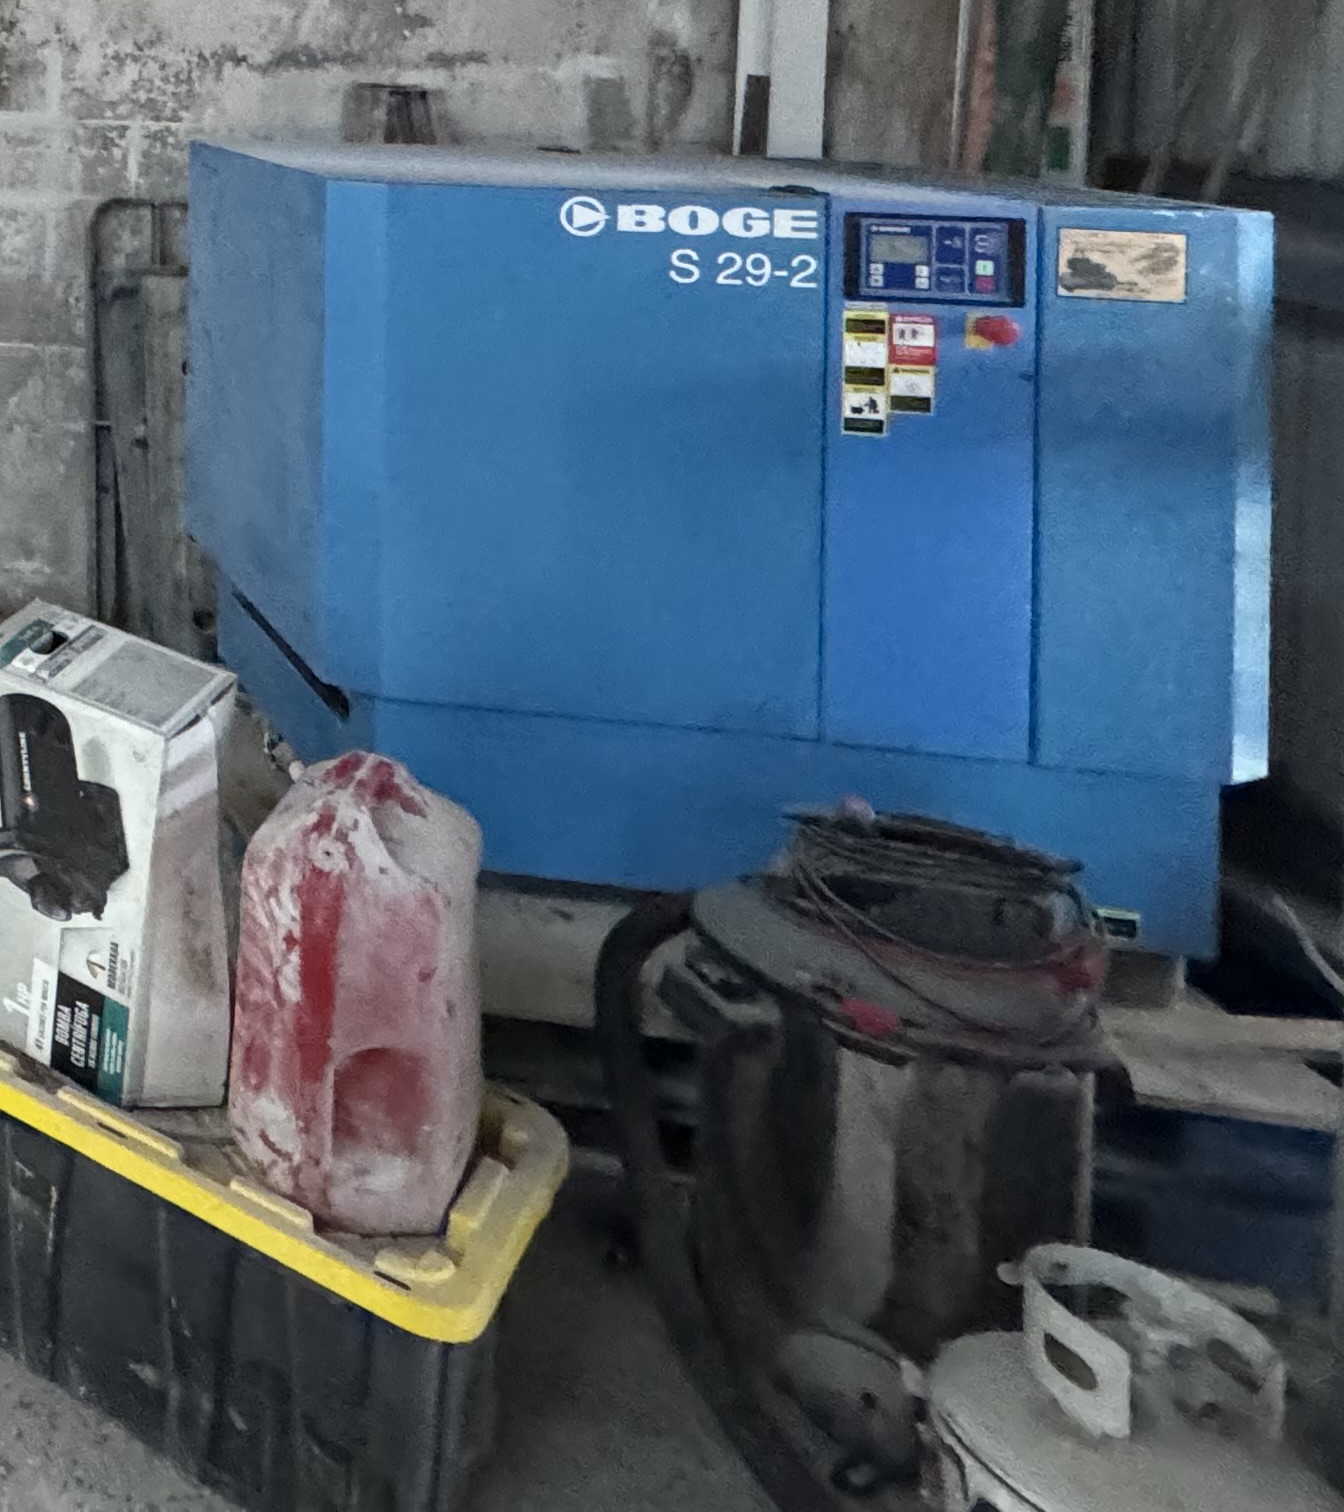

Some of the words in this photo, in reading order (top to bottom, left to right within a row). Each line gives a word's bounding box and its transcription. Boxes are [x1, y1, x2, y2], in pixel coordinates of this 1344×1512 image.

[616, 204, 818, 238] BOGE
[669, 249, 700, 284] S
[715, 252, 818, 288] 29-2
